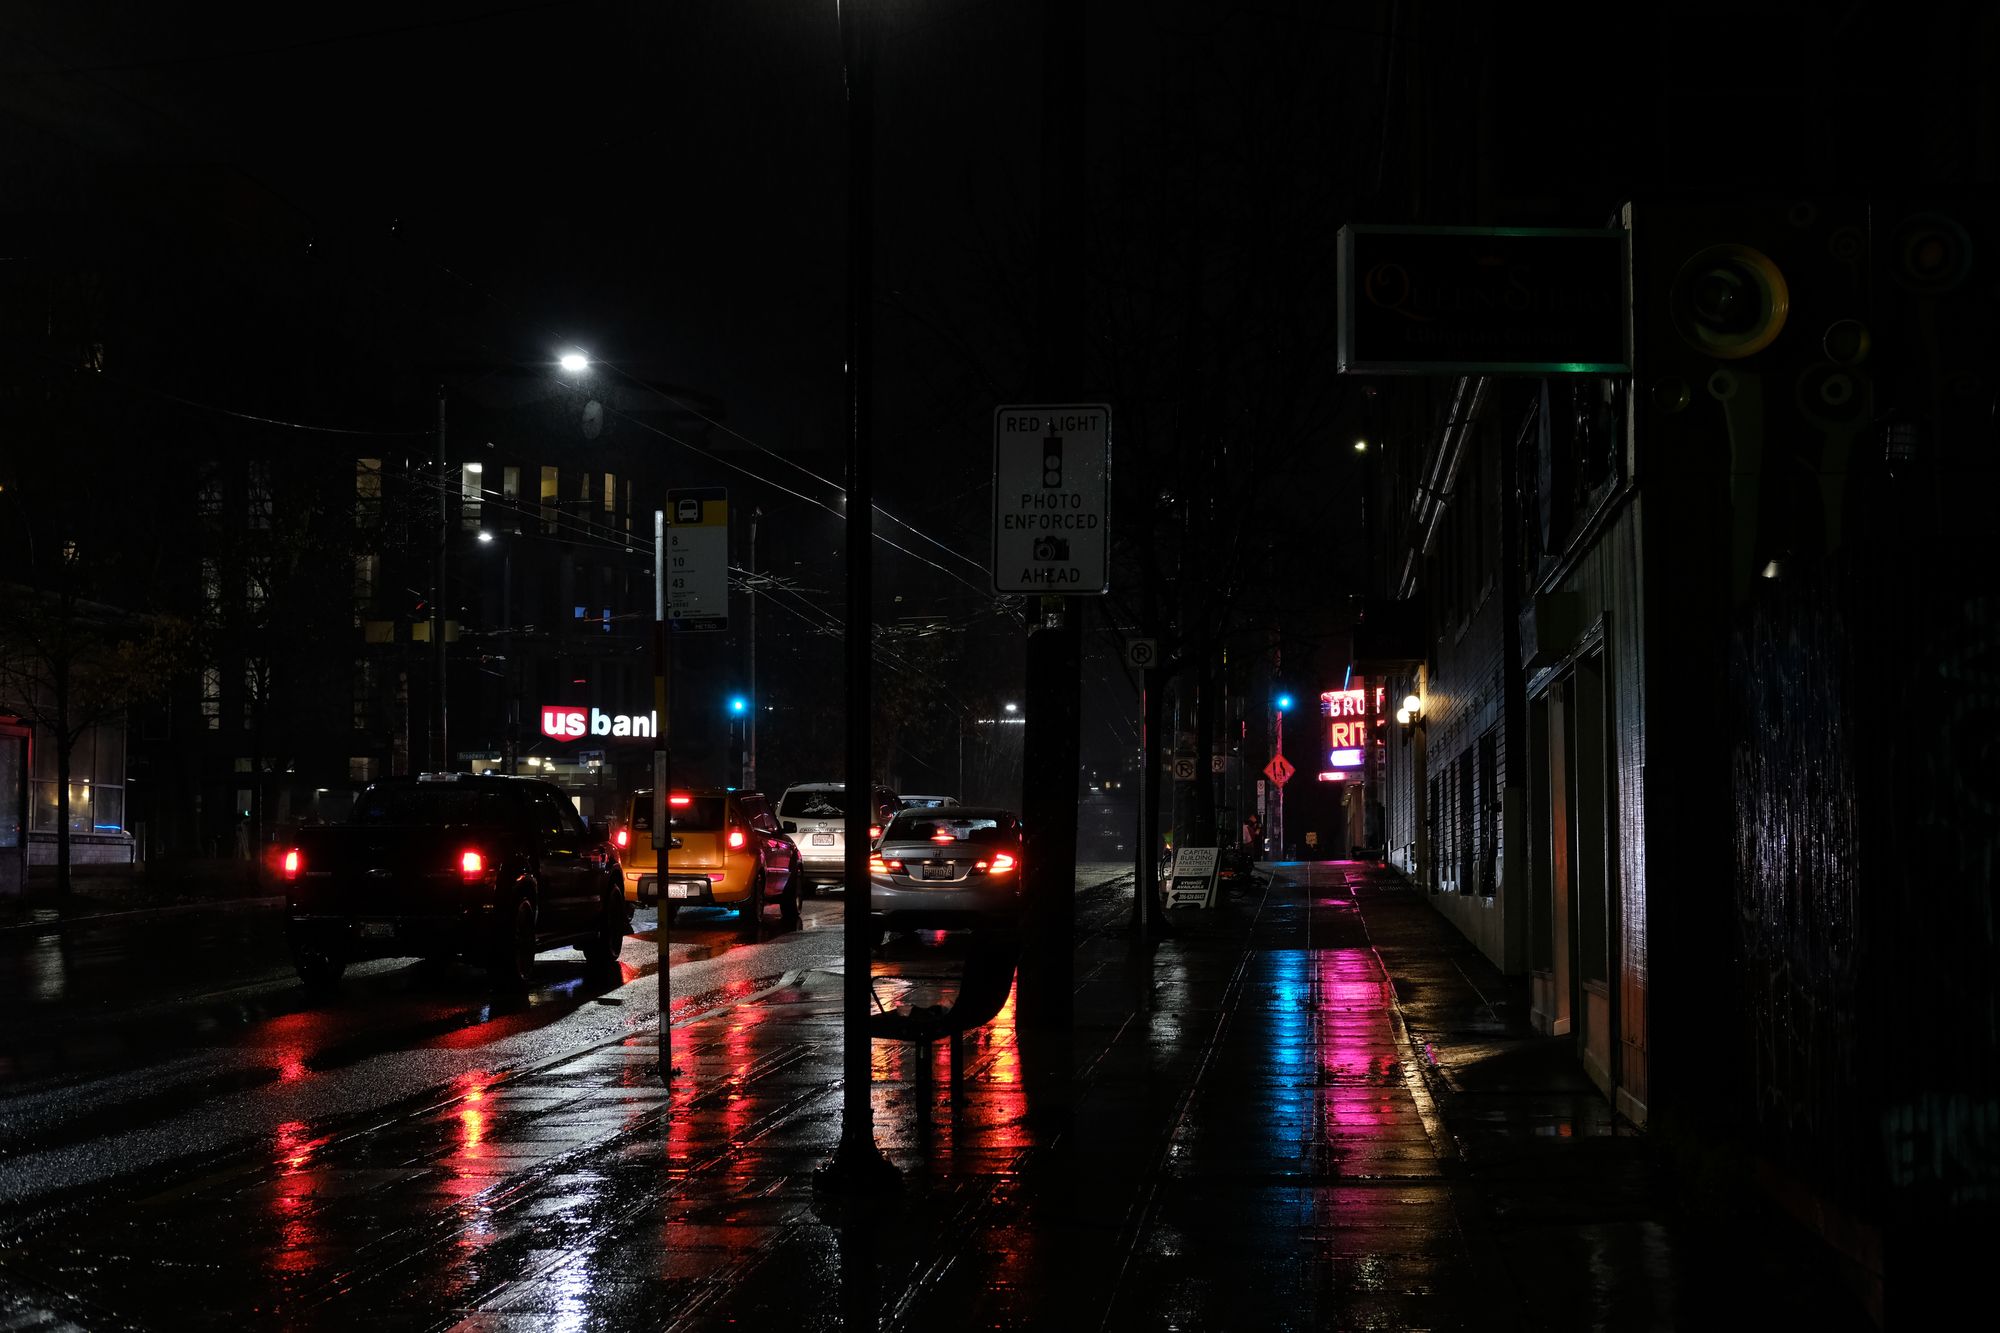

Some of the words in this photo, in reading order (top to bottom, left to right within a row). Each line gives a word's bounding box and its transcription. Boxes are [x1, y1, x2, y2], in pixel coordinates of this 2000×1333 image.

[1007, 417, 1040, 432] RED
[1051, 416, 1099, 432] LIGHT
[1022, 494, 1081, 509] PHOTO
[1004, 515, 1098, 529] ENFORCED
[672, 536, 678, 545] 8
[673, 557, 685, 567] 10
[1021, 568, 1080, 583] AHEAD
[672, 578, 684, 588] 43
[544, 712, 586, 736] us
